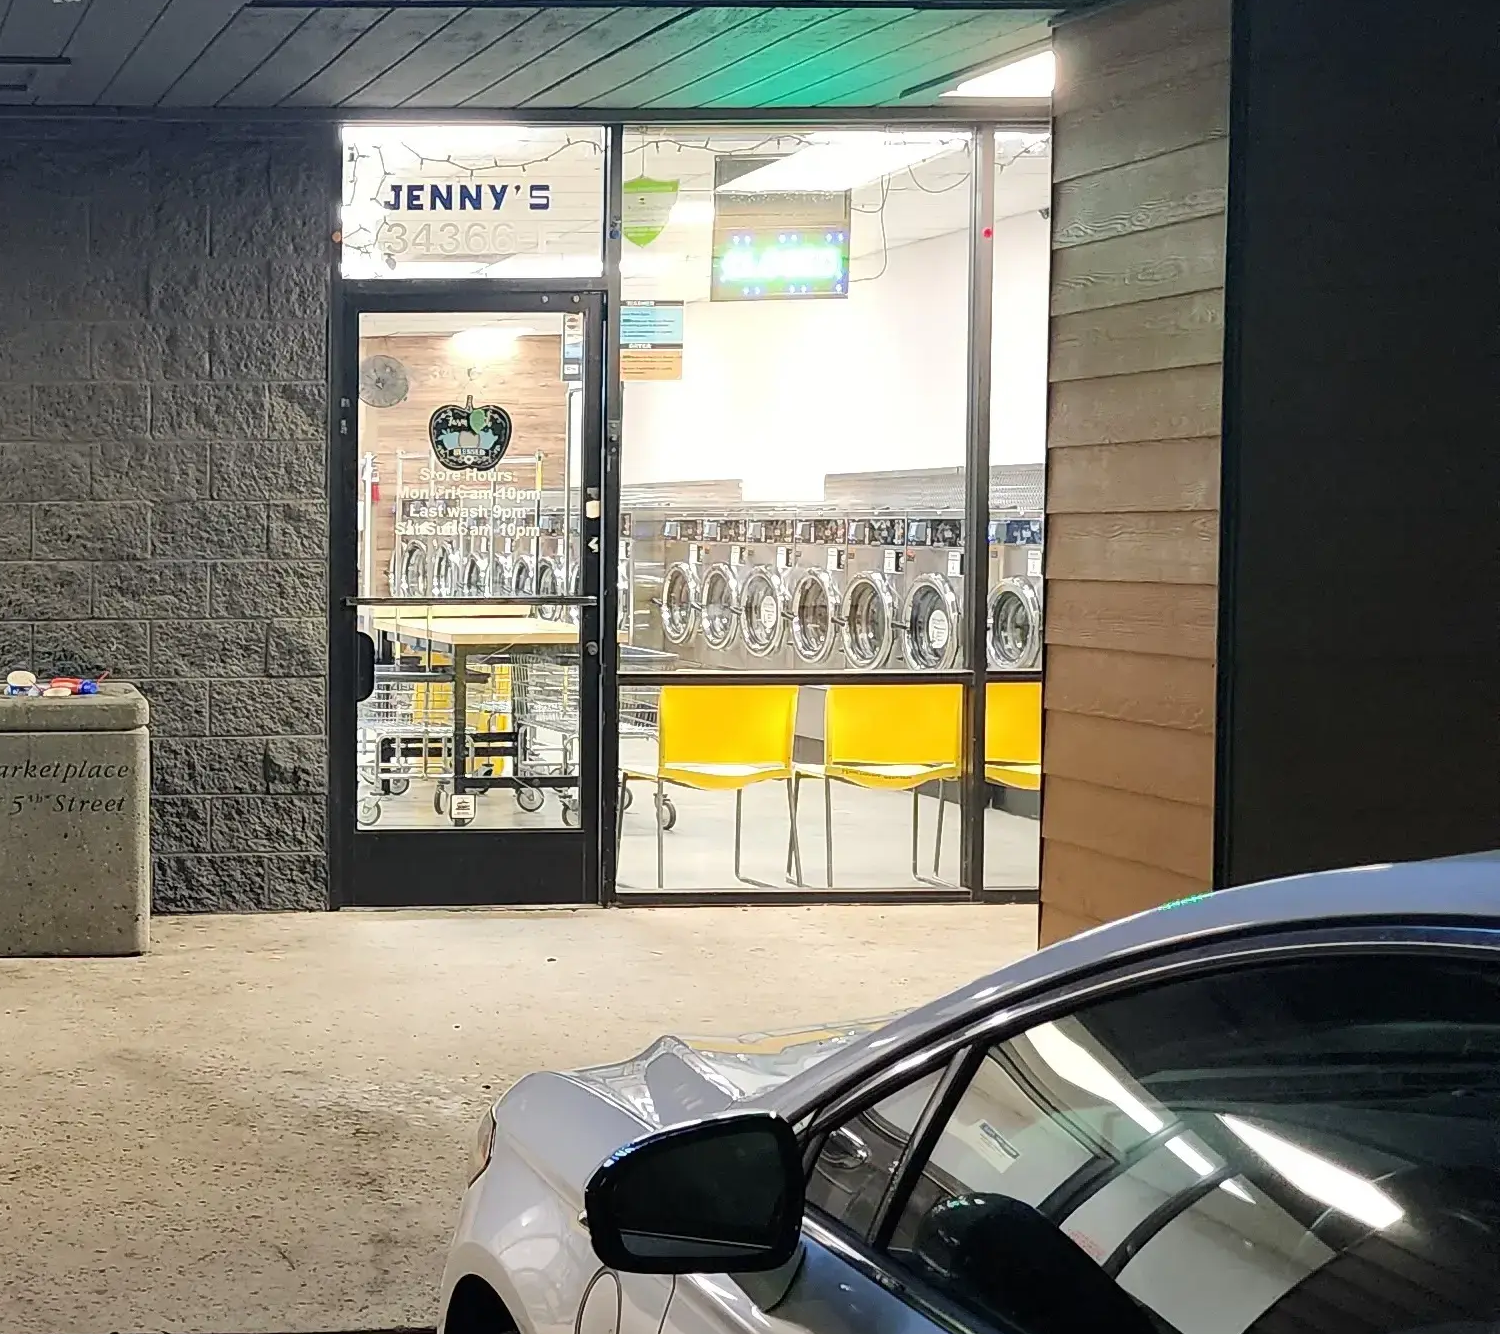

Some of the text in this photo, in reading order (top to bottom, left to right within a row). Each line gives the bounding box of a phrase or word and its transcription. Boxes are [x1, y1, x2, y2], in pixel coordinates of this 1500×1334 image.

[383, 184, 550, 211] JENNY'S
[419, 468, 461, 482] Store
[409, 503, 526, 521] Last wash 9pm
[52, 794, 127, 813] Street
